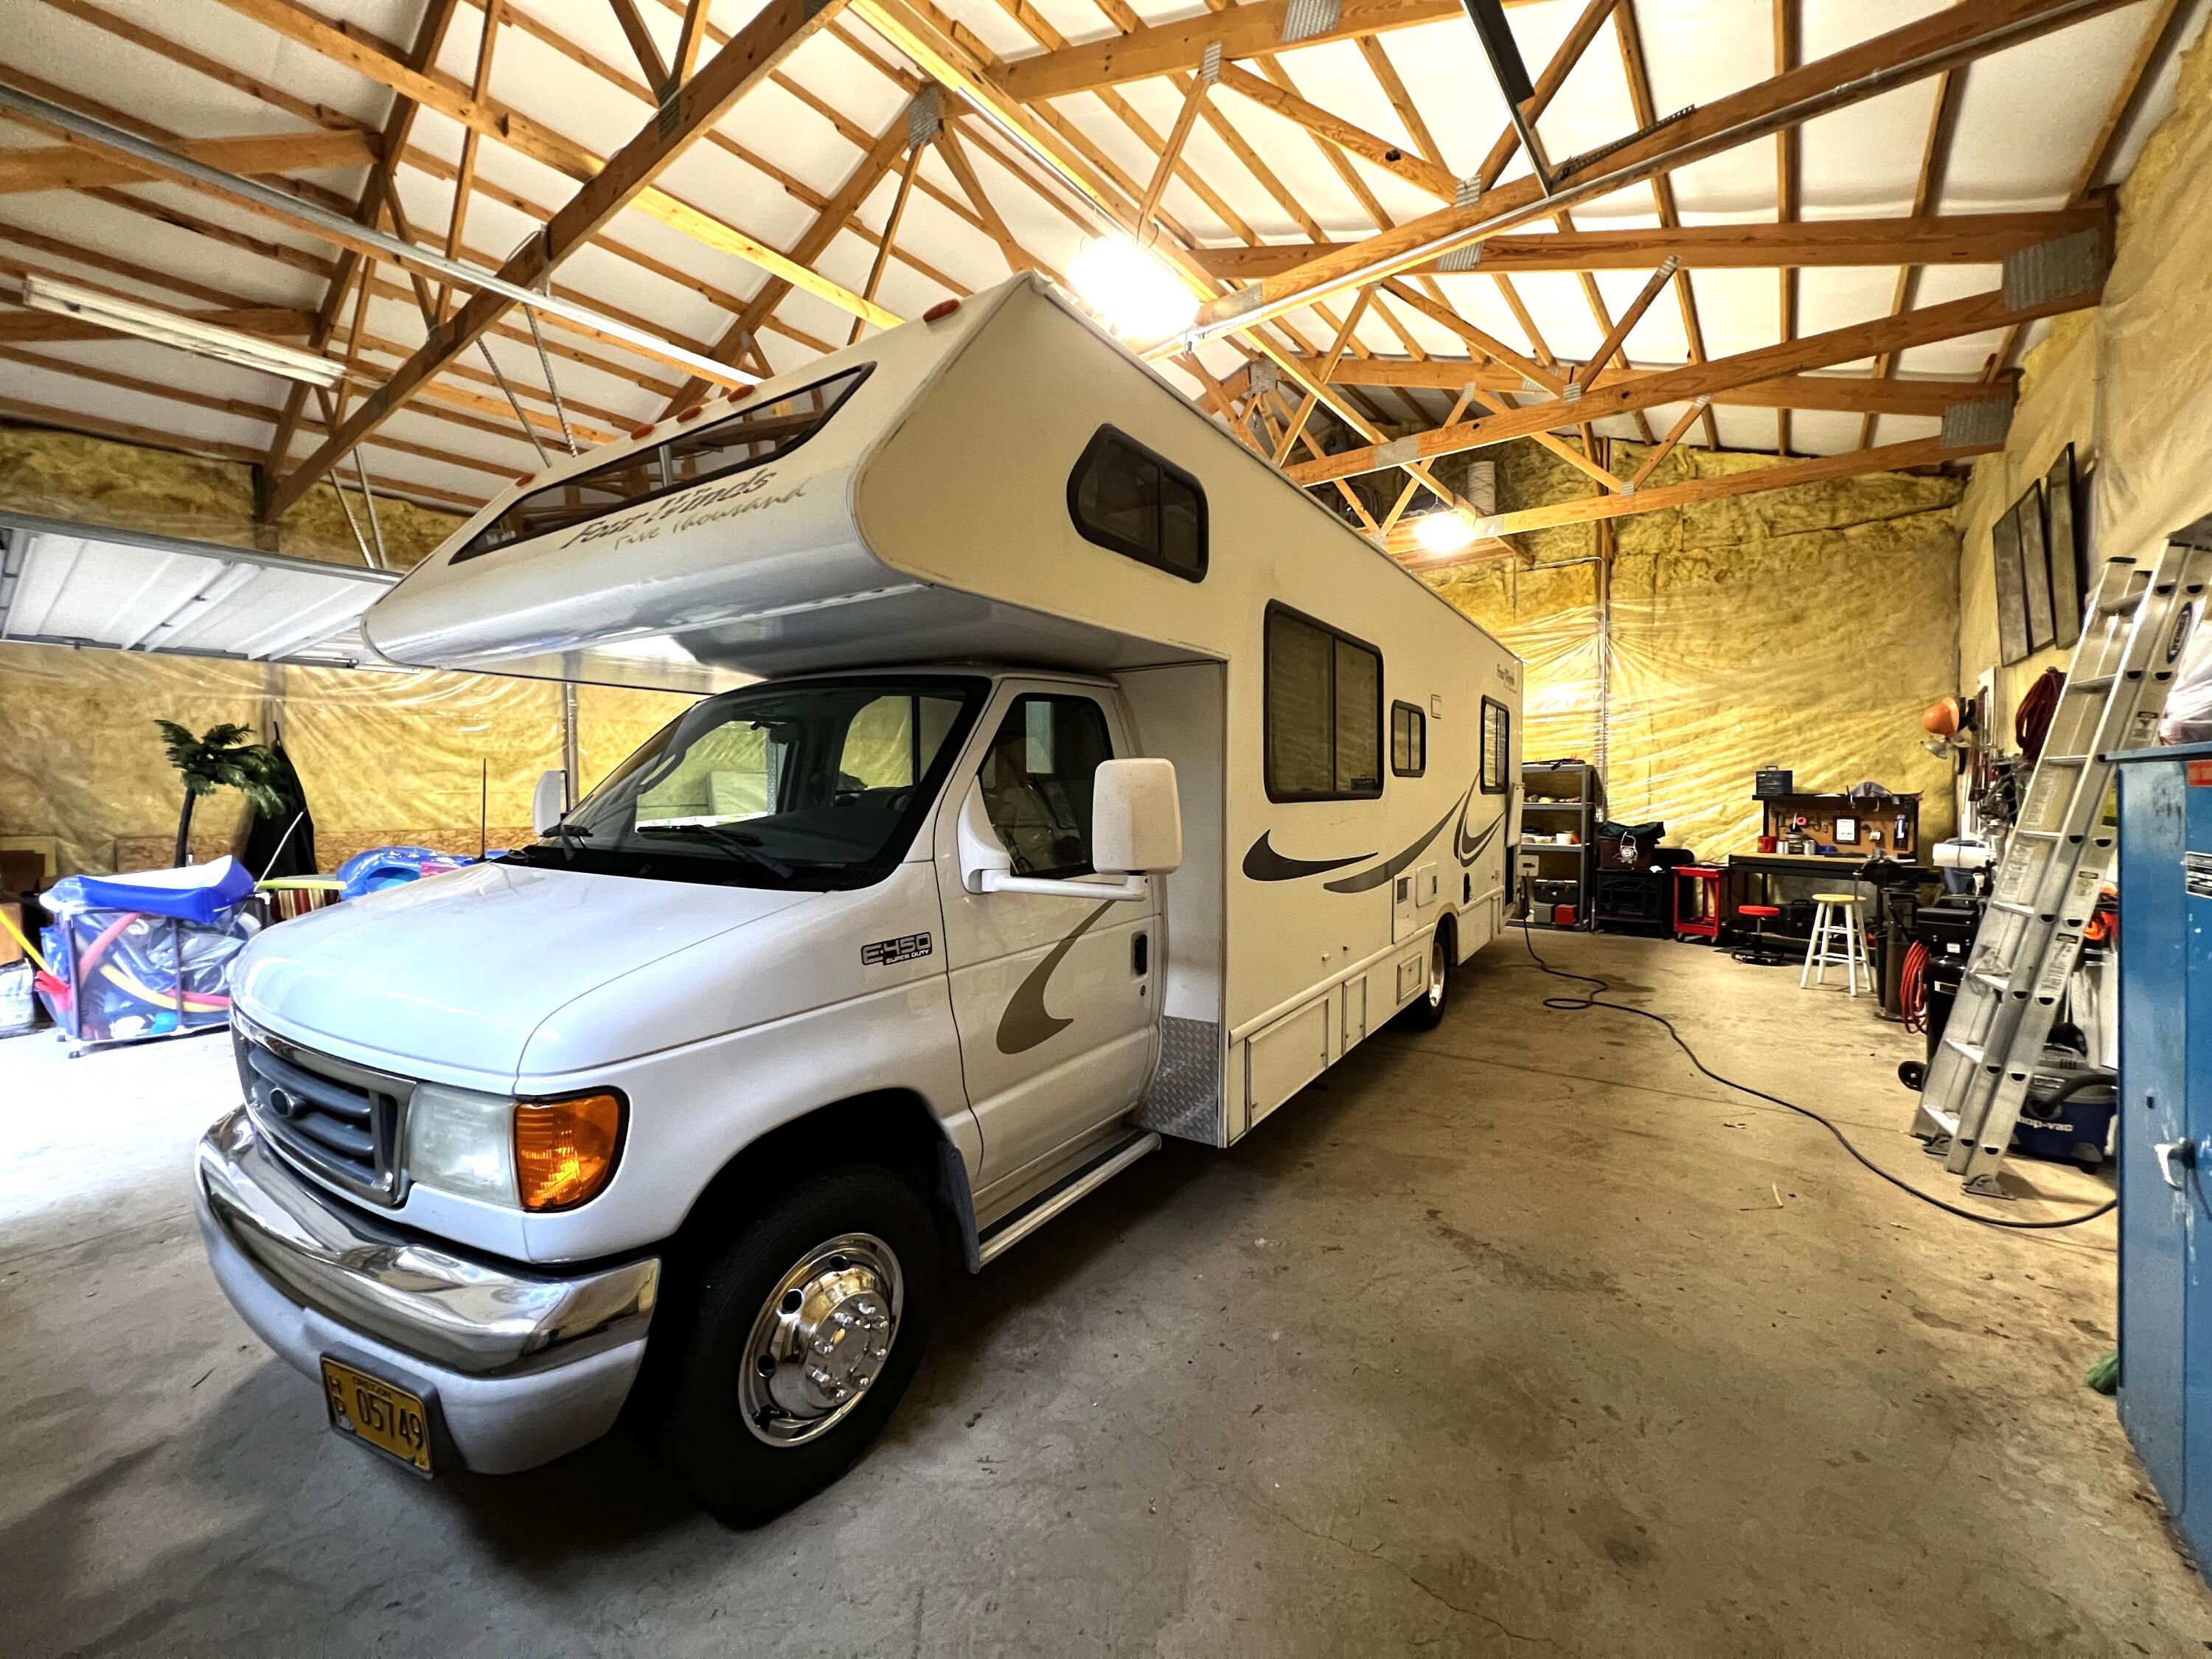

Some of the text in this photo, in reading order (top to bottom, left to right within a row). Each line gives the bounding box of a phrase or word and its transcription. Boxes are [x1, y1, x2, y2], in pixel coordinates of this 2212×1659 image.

[559, 468, 776, 549] Four Winds
[886, 949, 929, 964] SUPER DUTY
[356, 1388, 423, 1450] 05749
